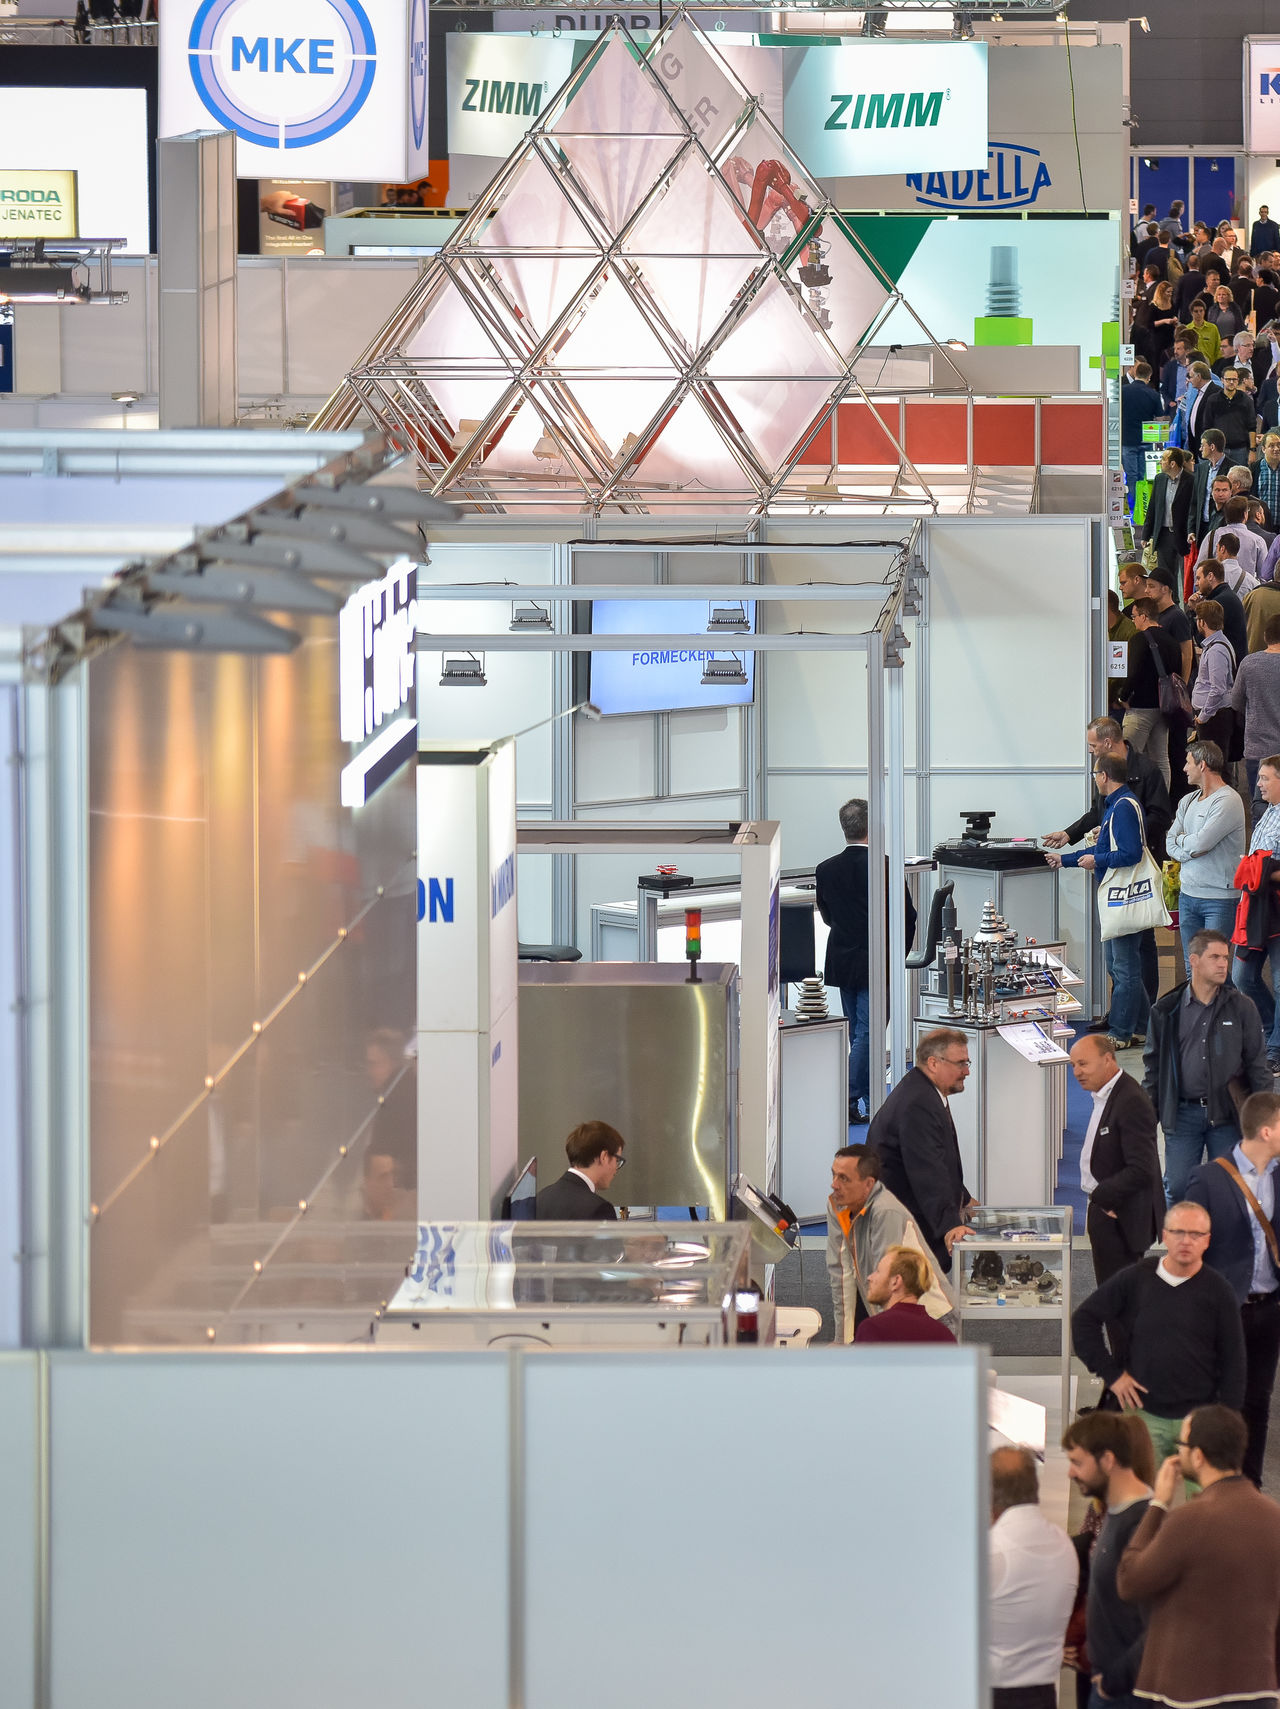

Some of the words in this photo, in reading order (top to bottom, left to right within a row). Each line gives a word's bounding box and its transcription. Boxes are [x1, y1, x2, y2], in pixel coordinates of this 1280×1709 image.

[231, 36, 335, 74] MKE
[462, 79, 543, 117] ZIMM
[824, 92, 944, 130] ZIMM
[2, 209, 62, 220] JENATEC
[632, 650, 714, 666] FORMECKEN
